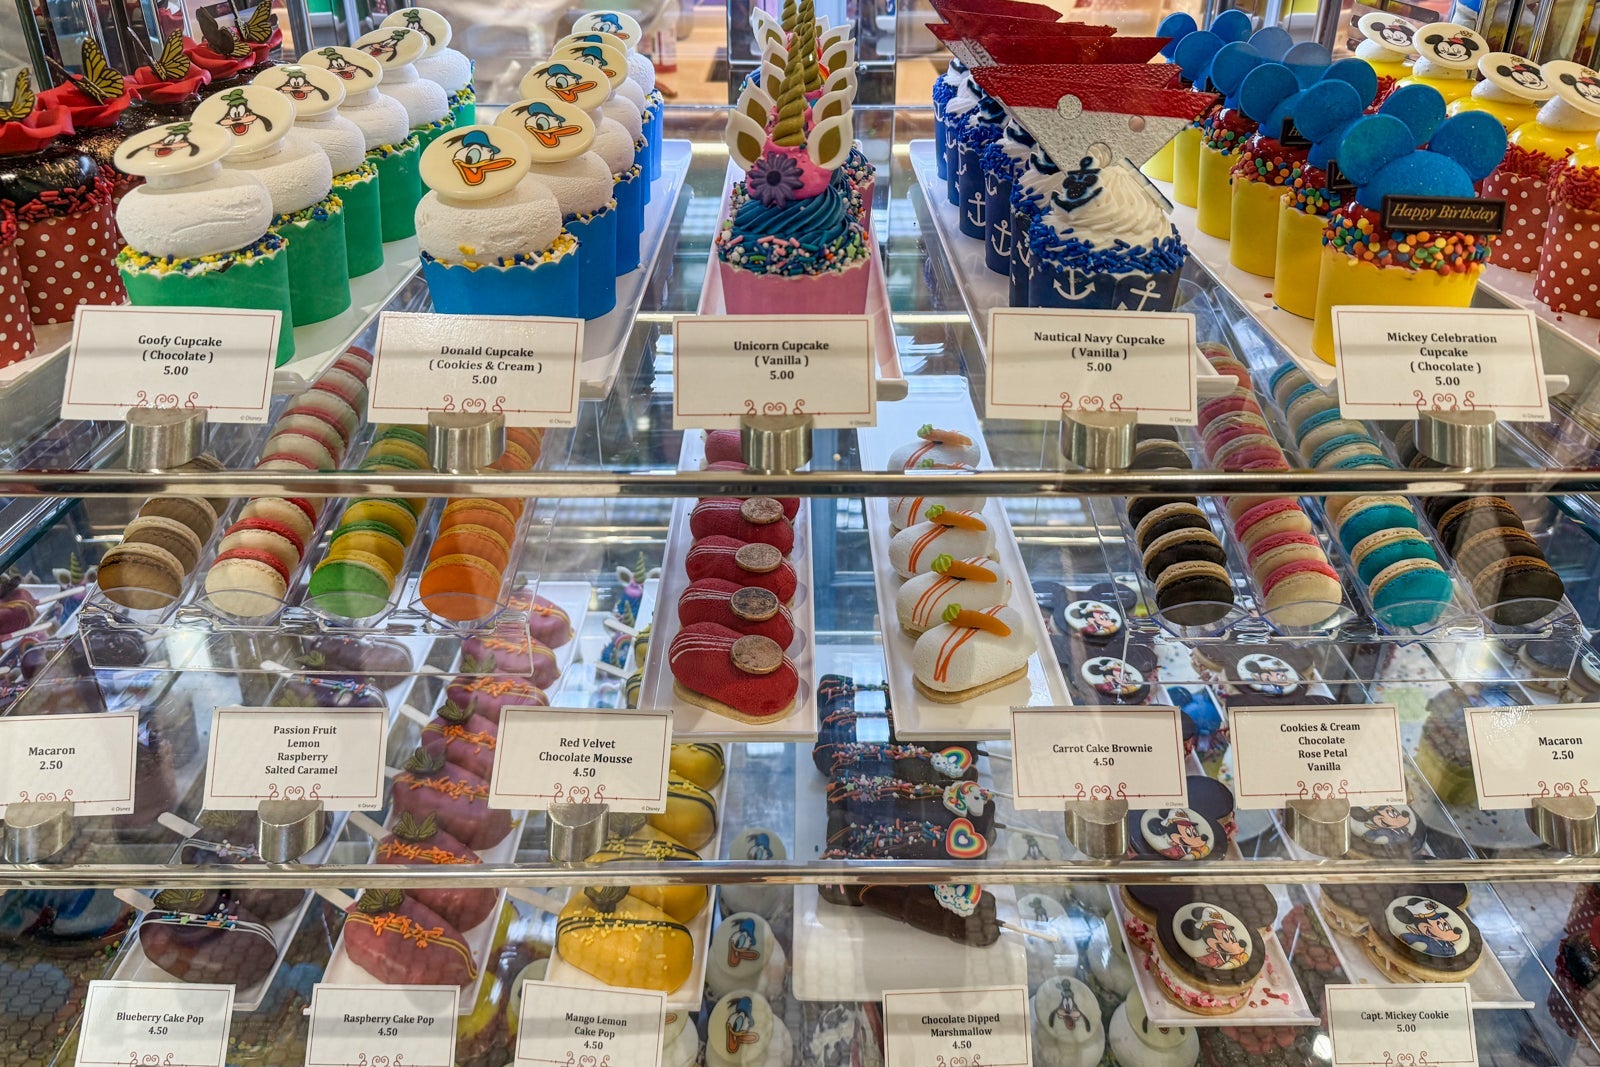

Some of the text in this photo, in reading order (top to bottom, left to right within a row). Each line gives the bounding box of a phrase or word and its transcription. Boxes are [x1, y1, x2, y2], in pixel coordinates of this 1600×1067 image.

[1391, 202, 1498, 222] Happy Birthday
[138, 335, 222, 349] Goofy Cupcake
[1034, 332, 1165, 347] Nautical Navy Cupcake
[1387, 332, 1497, 345] Mickey Celebration
[734, 340, 829, 353] Unicorn Cupcake
[440, 346, 534, 359] Donald Cupcake
[1420, 347, 1468, 359] Cupcake
[163, 365, 189, 376] 5.00
[485, 361, 494, 370] &
[1087, 362, 1112, 372] 5.00
[472, 375, 497, 384] 5.00
[770, 370, 794, 380] 5.00
[1435, 376, 1460, 386] 5.00
[273, 726, 337, 734] Passion Fruit
[1280, 722, 1360, 732] Cookies & Cream
[287, 739, 320, 748] Lemon
[560, 738, 616, 749] Red Velvet
[1298, 736, 1345, 745] Chocolate
[1538, 737, 1583, 746] Macaron
[28, 747, 75, 756] Macaron
[1052, 744, 1153, 753] Carrot Cake Brownie
[1298, 748, 1348, 758] Rose Petal
[277, 752, 328, 763] Raspberry
[539, 751, 633, 764] Chocolate Mousse
[1552, 750, 1574, 760] 2.50
[39, 760, 63, 770] 2.50
[1093, 757, 1115, 766] 4.50
[1307, 762, 1341, 771] Vanilla
[265, 765, 338, 775] Salted Caramel
[573, 767, 596, 778] 4.50
[116, 1012, 204, 1025] Blueberry Cake Pop
[343, 1014, 435, 1026] Raspberry Cake Pop
[565, 1013, 627, 1026] Mango Lemon
[921, 1013, 1000, 1025] Chocolate Dipped
[1360, 1011, 1449, 1022] Capt. Mickey Cookie
[148, 1026, 168, 1035] 4.50
[378, 1027, 398, 1036] 4.50
[574, 1026, 615, 1040] Cake Pop
[930, 1026, 993, 1037] Marshmallow
[1397, 1024, 1416, 1032] 5.00
[584, 1040, 603, 1050] 4.50
[952, 1040, 972, 1049] 4.50
